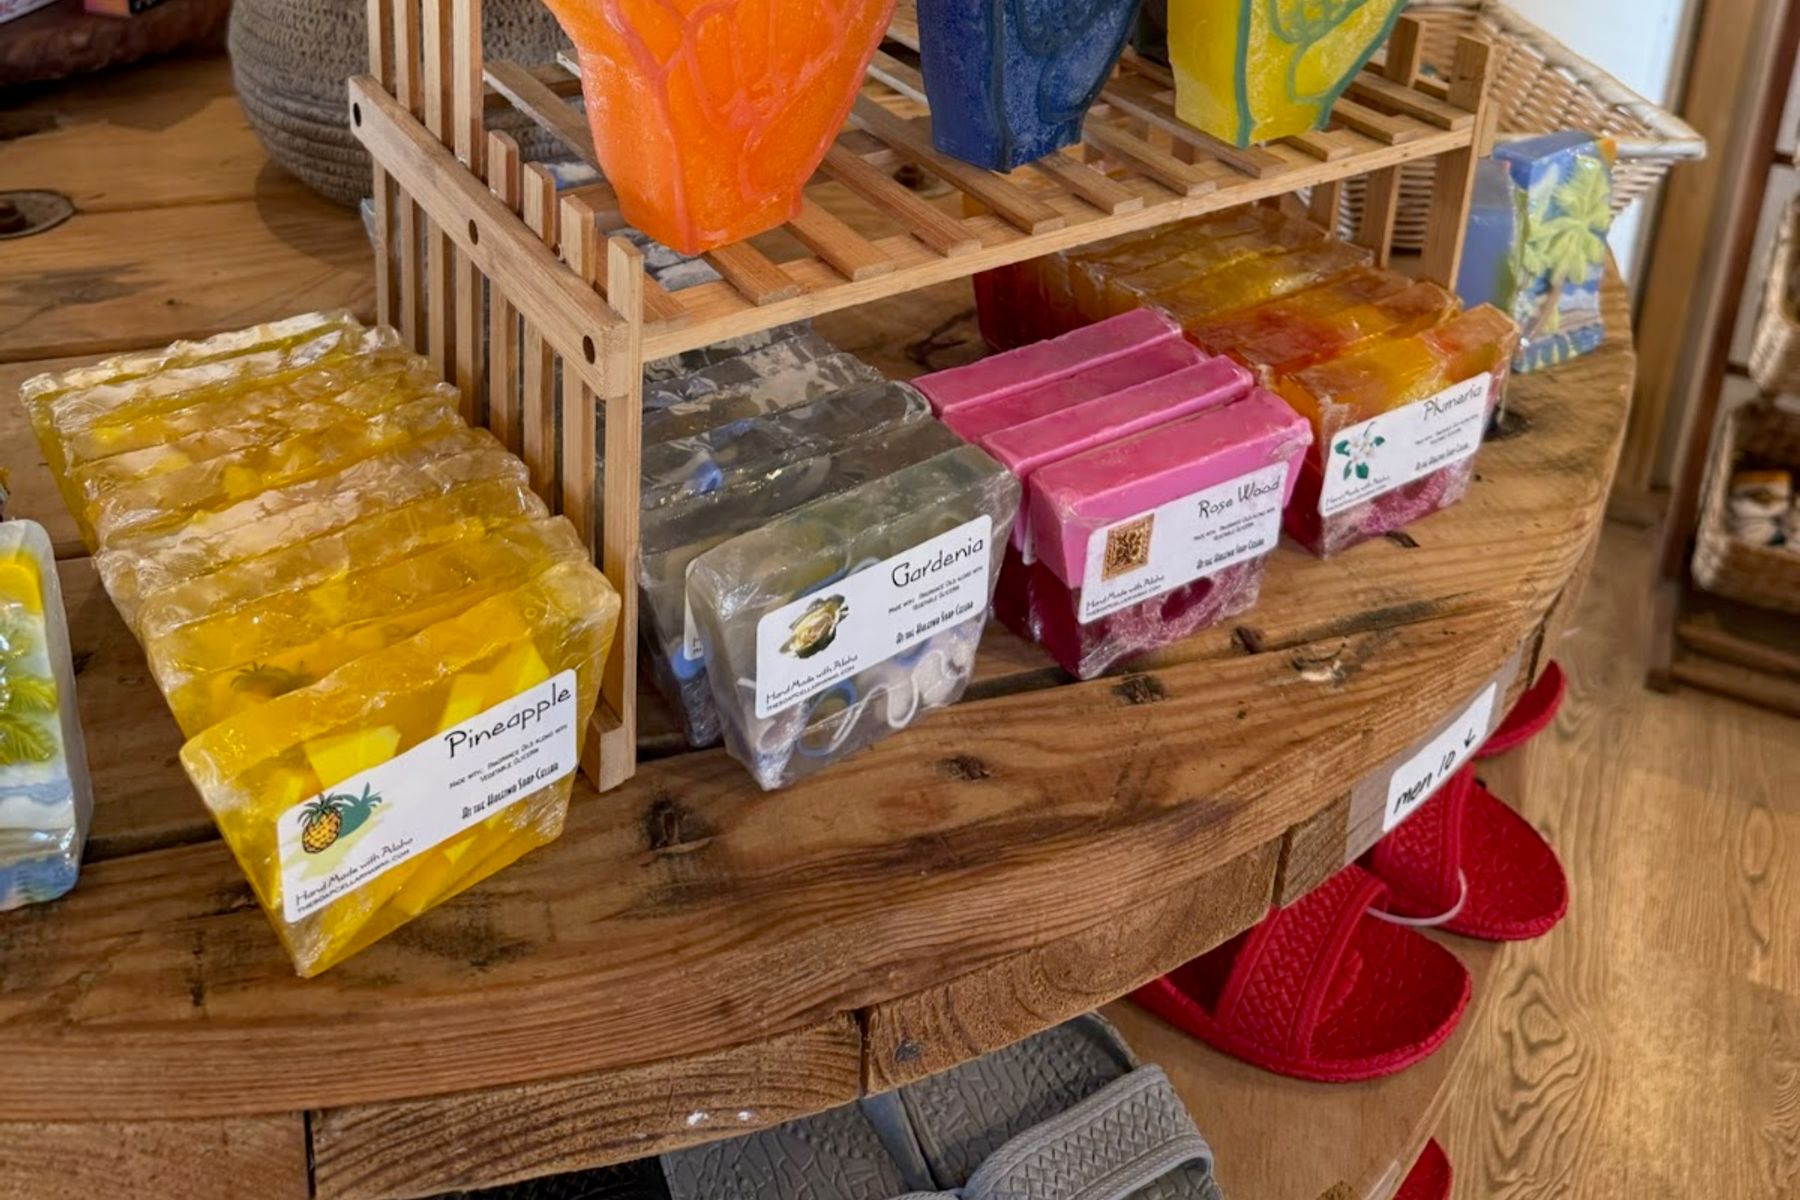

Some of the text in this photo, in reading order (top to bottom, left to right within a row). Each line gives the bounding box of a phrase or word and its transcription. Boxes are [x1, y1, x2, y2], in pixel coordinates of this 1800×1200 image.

[1198, 475, 1280, 518] Rose Wood
[891, 537, 984, 588] Gardenia
[766, 655, 858, 705] Hand Made with Aloha
[444, 683, 572, 758] Pineapple
[1394, 750, 1456, 814] men 10
[296, 838, 414, 906] Hand Made with Aloha
